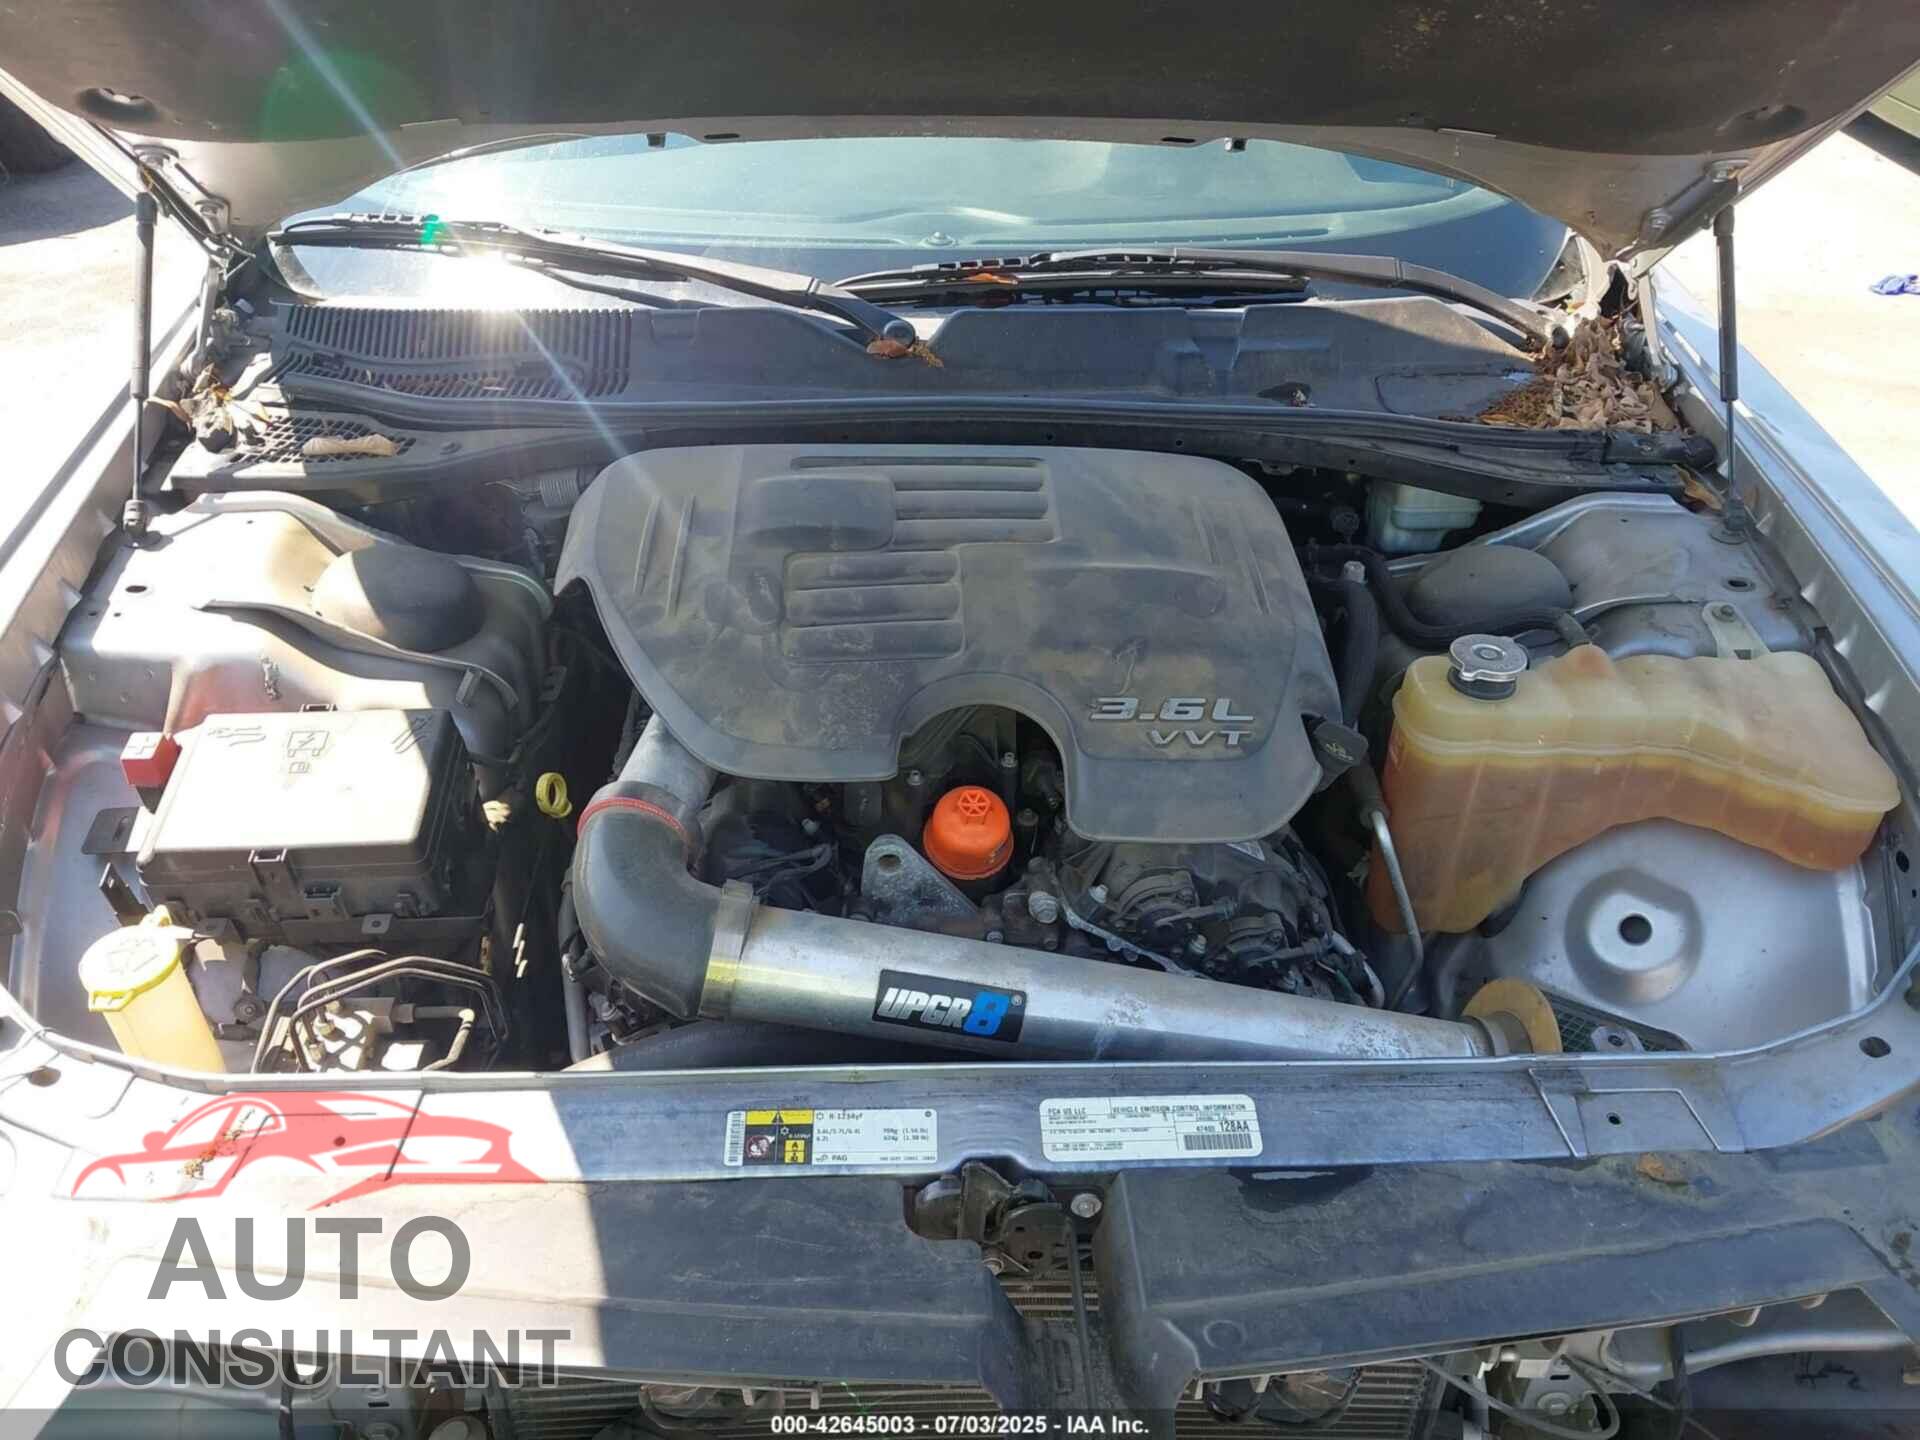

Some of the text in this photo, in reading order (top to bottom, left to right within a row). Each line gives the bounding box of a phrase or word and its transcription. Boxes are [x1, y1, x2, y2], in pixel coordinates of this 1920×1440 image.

[1090, 697, 1254, 721] 3.6L
[1149, 729, 1252, 746] VVT
[876, 986, 1010, 1036] UPGR8
